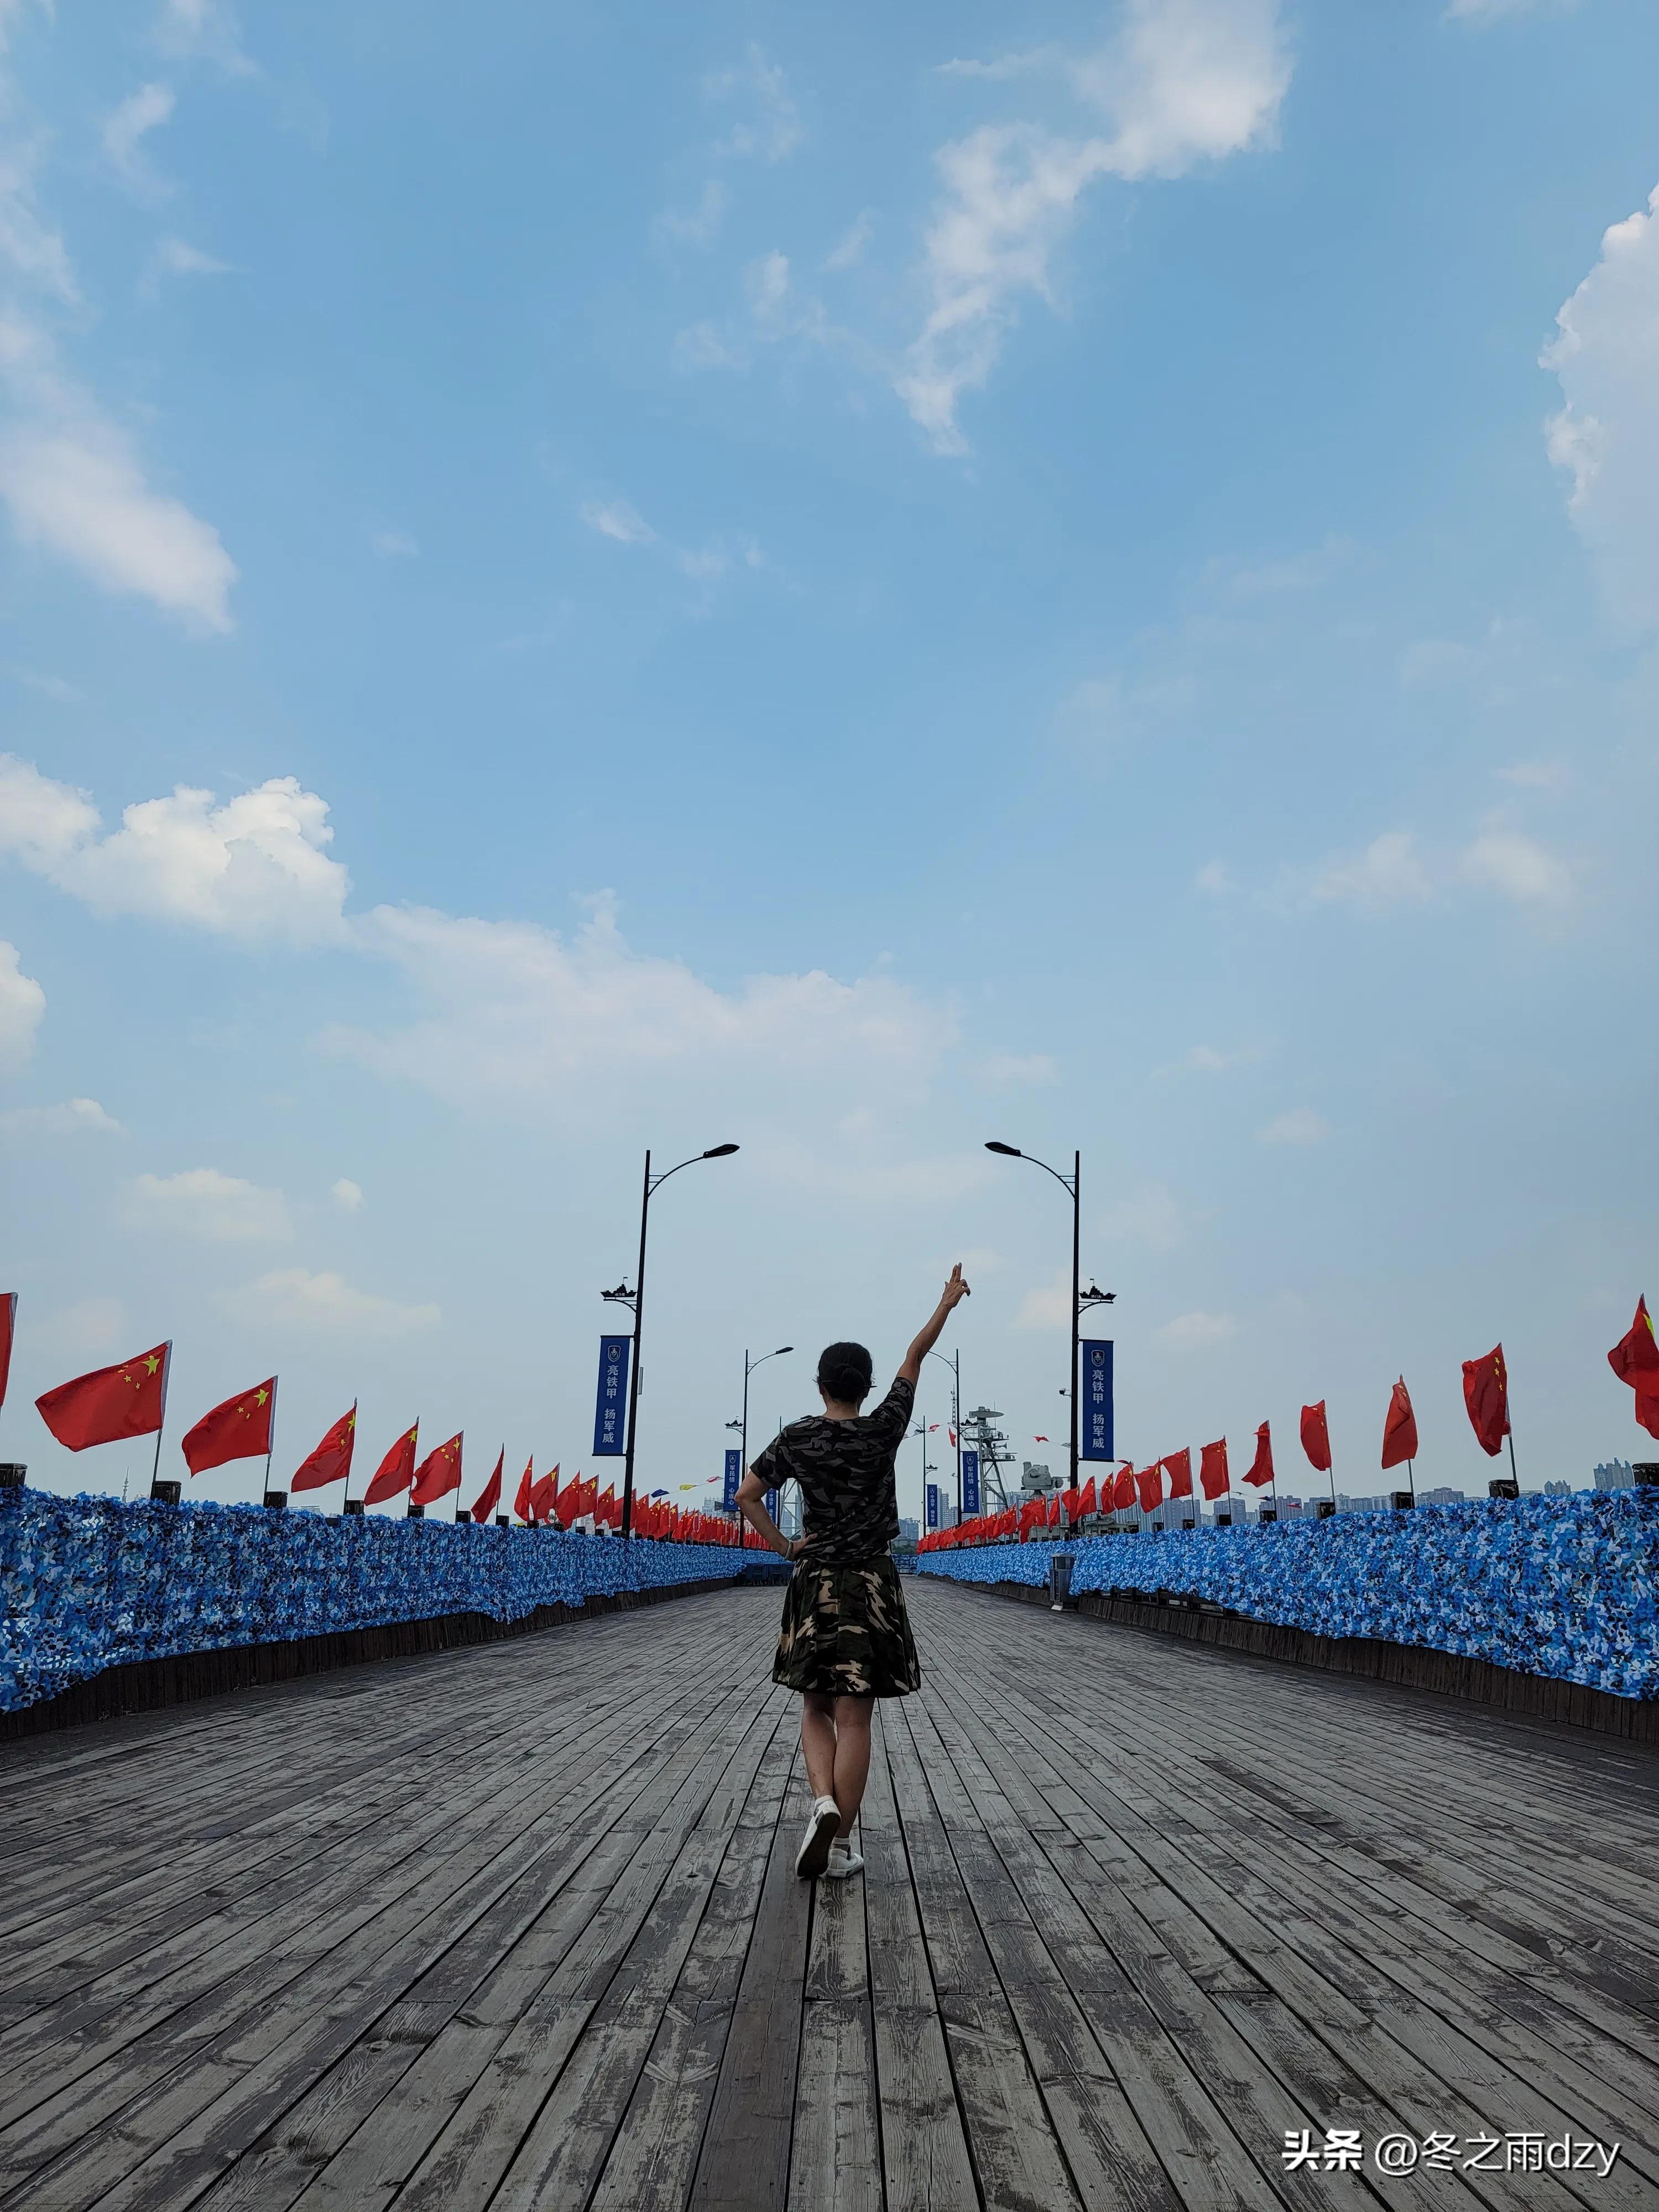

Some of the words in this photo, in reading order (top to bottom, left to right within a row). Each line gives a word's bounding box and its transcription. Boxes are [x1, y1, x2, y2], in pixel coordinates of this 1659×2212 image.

[606, 1365, 619, 1399] 亮铁甲
[1092, 1369, 1104, 1404] 亮铁甲
[602, 1408, 616, 1443] 扬军威
[1092, 1413, 1105, 1449] 扬军威
